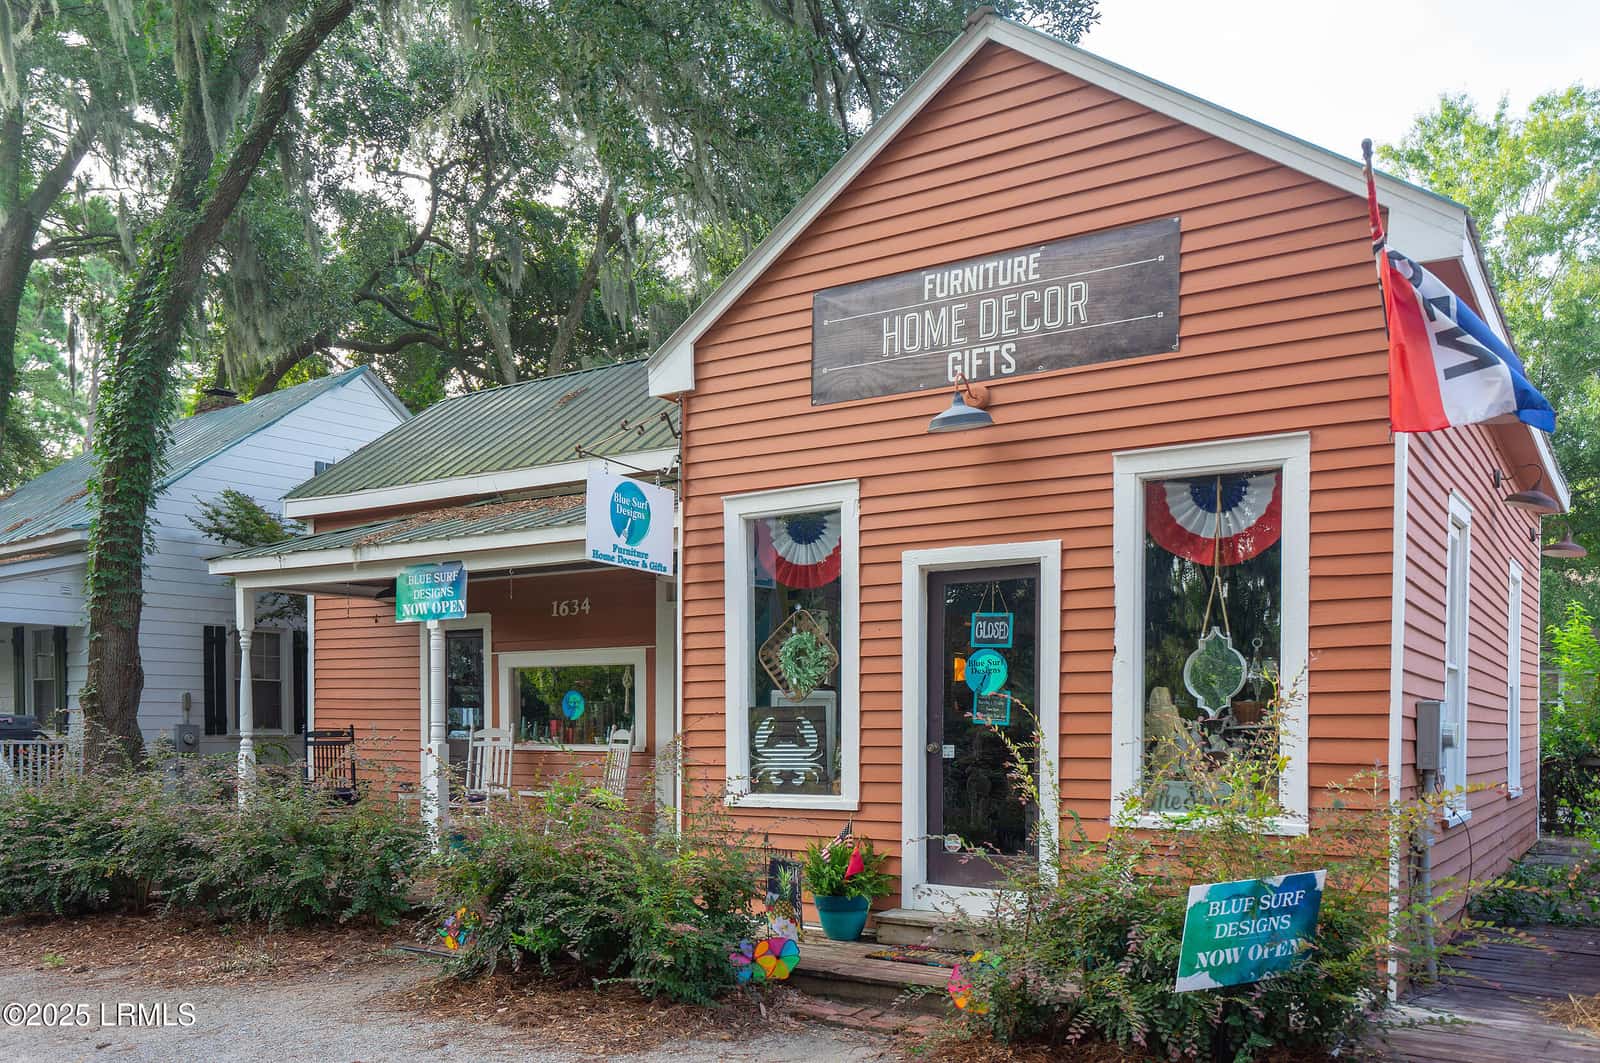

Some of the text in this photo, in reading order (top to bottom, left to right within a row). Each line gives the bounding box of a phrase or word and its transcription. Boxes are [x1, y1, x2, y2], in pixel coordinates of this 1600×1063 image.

[923, 252, 1042, 300] FURNITURE
[882, 281, 1088, 357] HOME DECOR
[947, 343, 1016, 383] GIFTS
[614, 492, 648, 510] Blue Surf
[616, 504, 645, 520] Designs
[592, 549, 667, 572] Home Decor & Gifts
[613, 544, 648, 559] Furniture
[408, 570, 459, 585] BLUE SURF
[413, 586, 455, 600] DESIGNS
[402, 600, 465, 616] NOW OPEN
[552, 597, 591, 617] 1634
[975, 621, 1009, 640] CLOSED
[1208, 890, 1306, 917] BLUE SURF
[1214, 914, 1291, 939] DESIGNS
[1195, 946, 1244, 969] NOW
